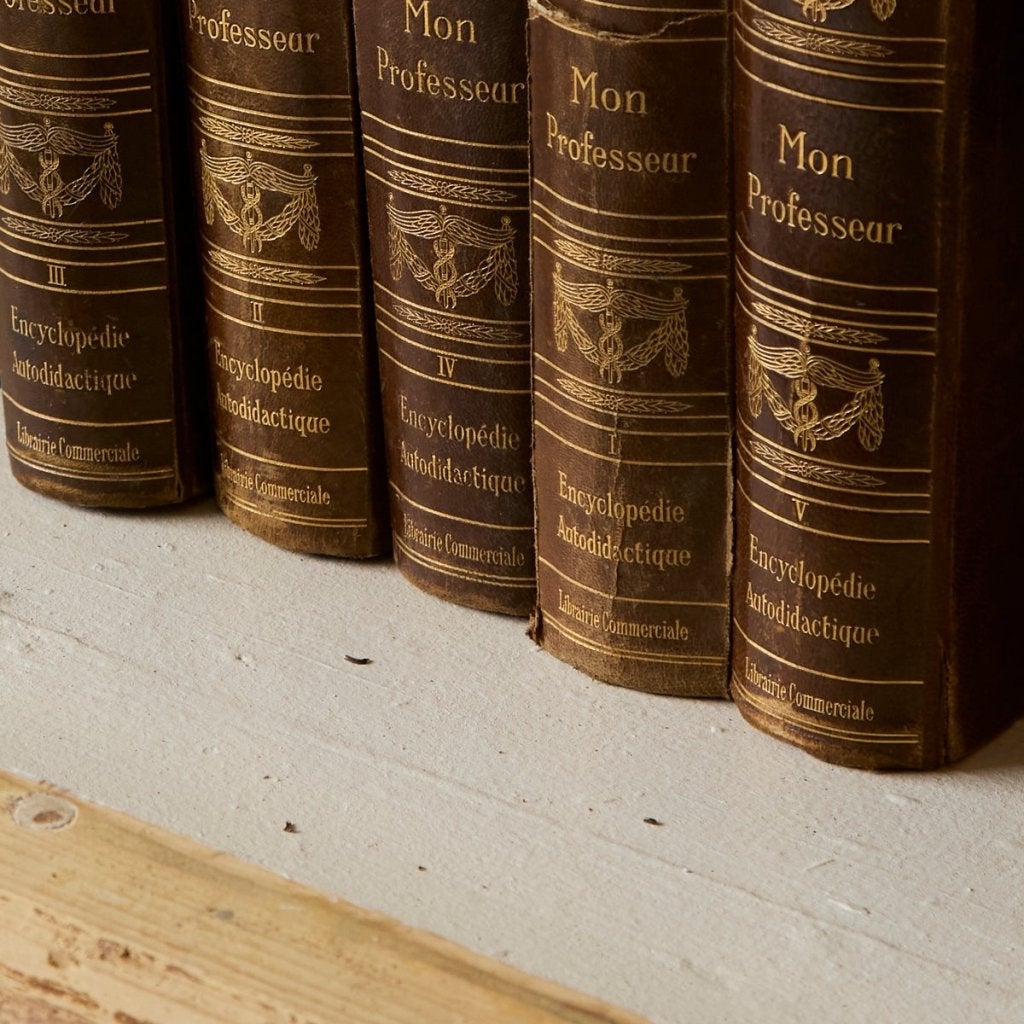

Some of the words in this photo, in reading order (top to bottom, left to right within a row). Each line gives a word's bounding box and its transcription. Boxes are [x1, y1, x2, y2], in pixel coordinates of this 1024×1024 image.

[376, 45, 525, 105] Professeur
[570, 65, 648, 115] Mon
[546, 112, 697, 174] Professeur
[778, 123, 855, 181] Mon
[747, 171, 903, 244] Professeur
[10, 305, 131, 355] Encyclopédie
[12, 350, 138, 396] Autodidactique
[214, 339, 323, 393] Encyclopédie
[437, 355, 458, 378] IV
[16, 421, 57, 456] Librairie
[58, 436, 141, 463] Commerciale
[399, 394, 521, 451] Encyclopédie
[255, 473, 331, 506] Commerciale
[399, 440, 526, 497] Autodidactique
[558, 470, 685, 527] Encyclopédie
[791, 498, 810, 522] V
[445, 532, 525, 567] Commerciale
[557, 514, 692, 571] Autodidactique
[749, 533, 877, 601] Encyclopédie
[558, 588, 600, 629] Librairie
[601, 610, 689, 641] Commerciale
[746, 582, 880, 648] Autodidactique
[745, 656, 787, 701] Librairie
[789, 682, 875, 722] Commerciale
